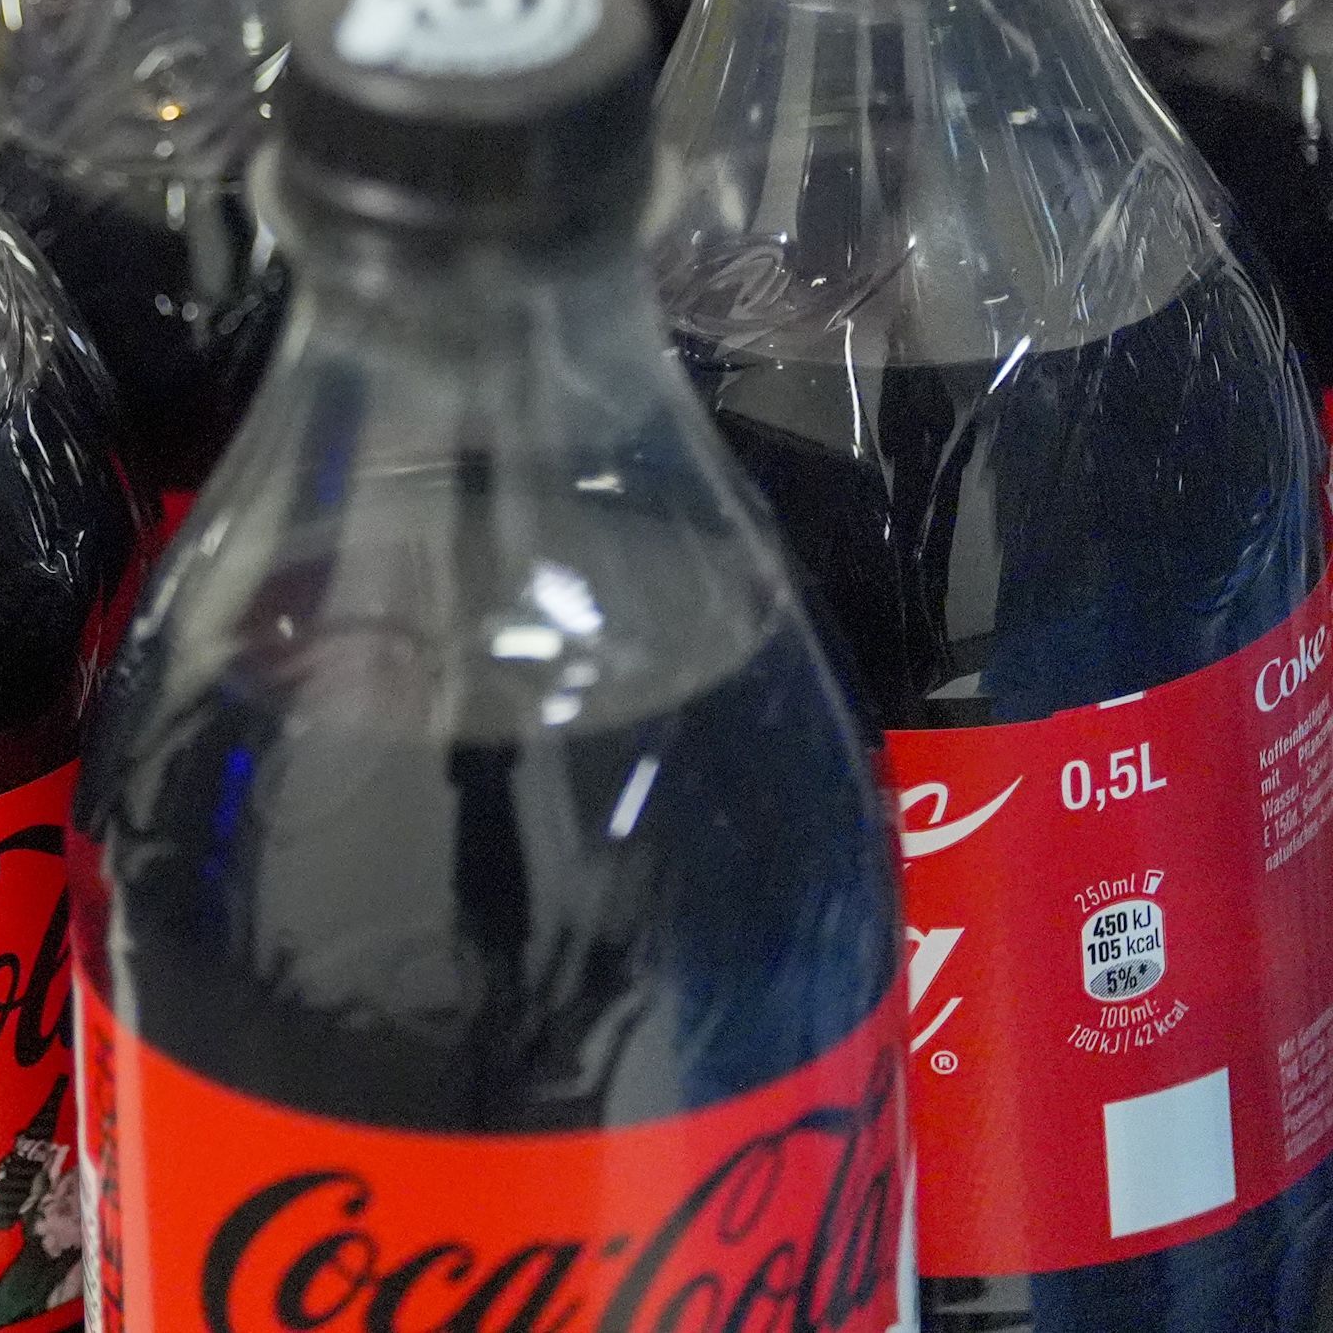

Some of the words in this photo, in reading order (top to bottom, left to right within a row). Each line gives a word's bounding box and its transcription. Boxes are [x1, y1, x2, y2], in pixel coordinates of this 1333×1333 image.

[1255, 624, 1325, 712] Coke
[1061, 742, 1167, 812] 0,5L
[1074, 872, 1135, 913] 250ml
[1093, 912, 1128, 938] 450
[1133, 905, 1151, 930] kJ
[1088, 939, 1121, 965] 105
[1127, 928, 1161, 956] kcal
